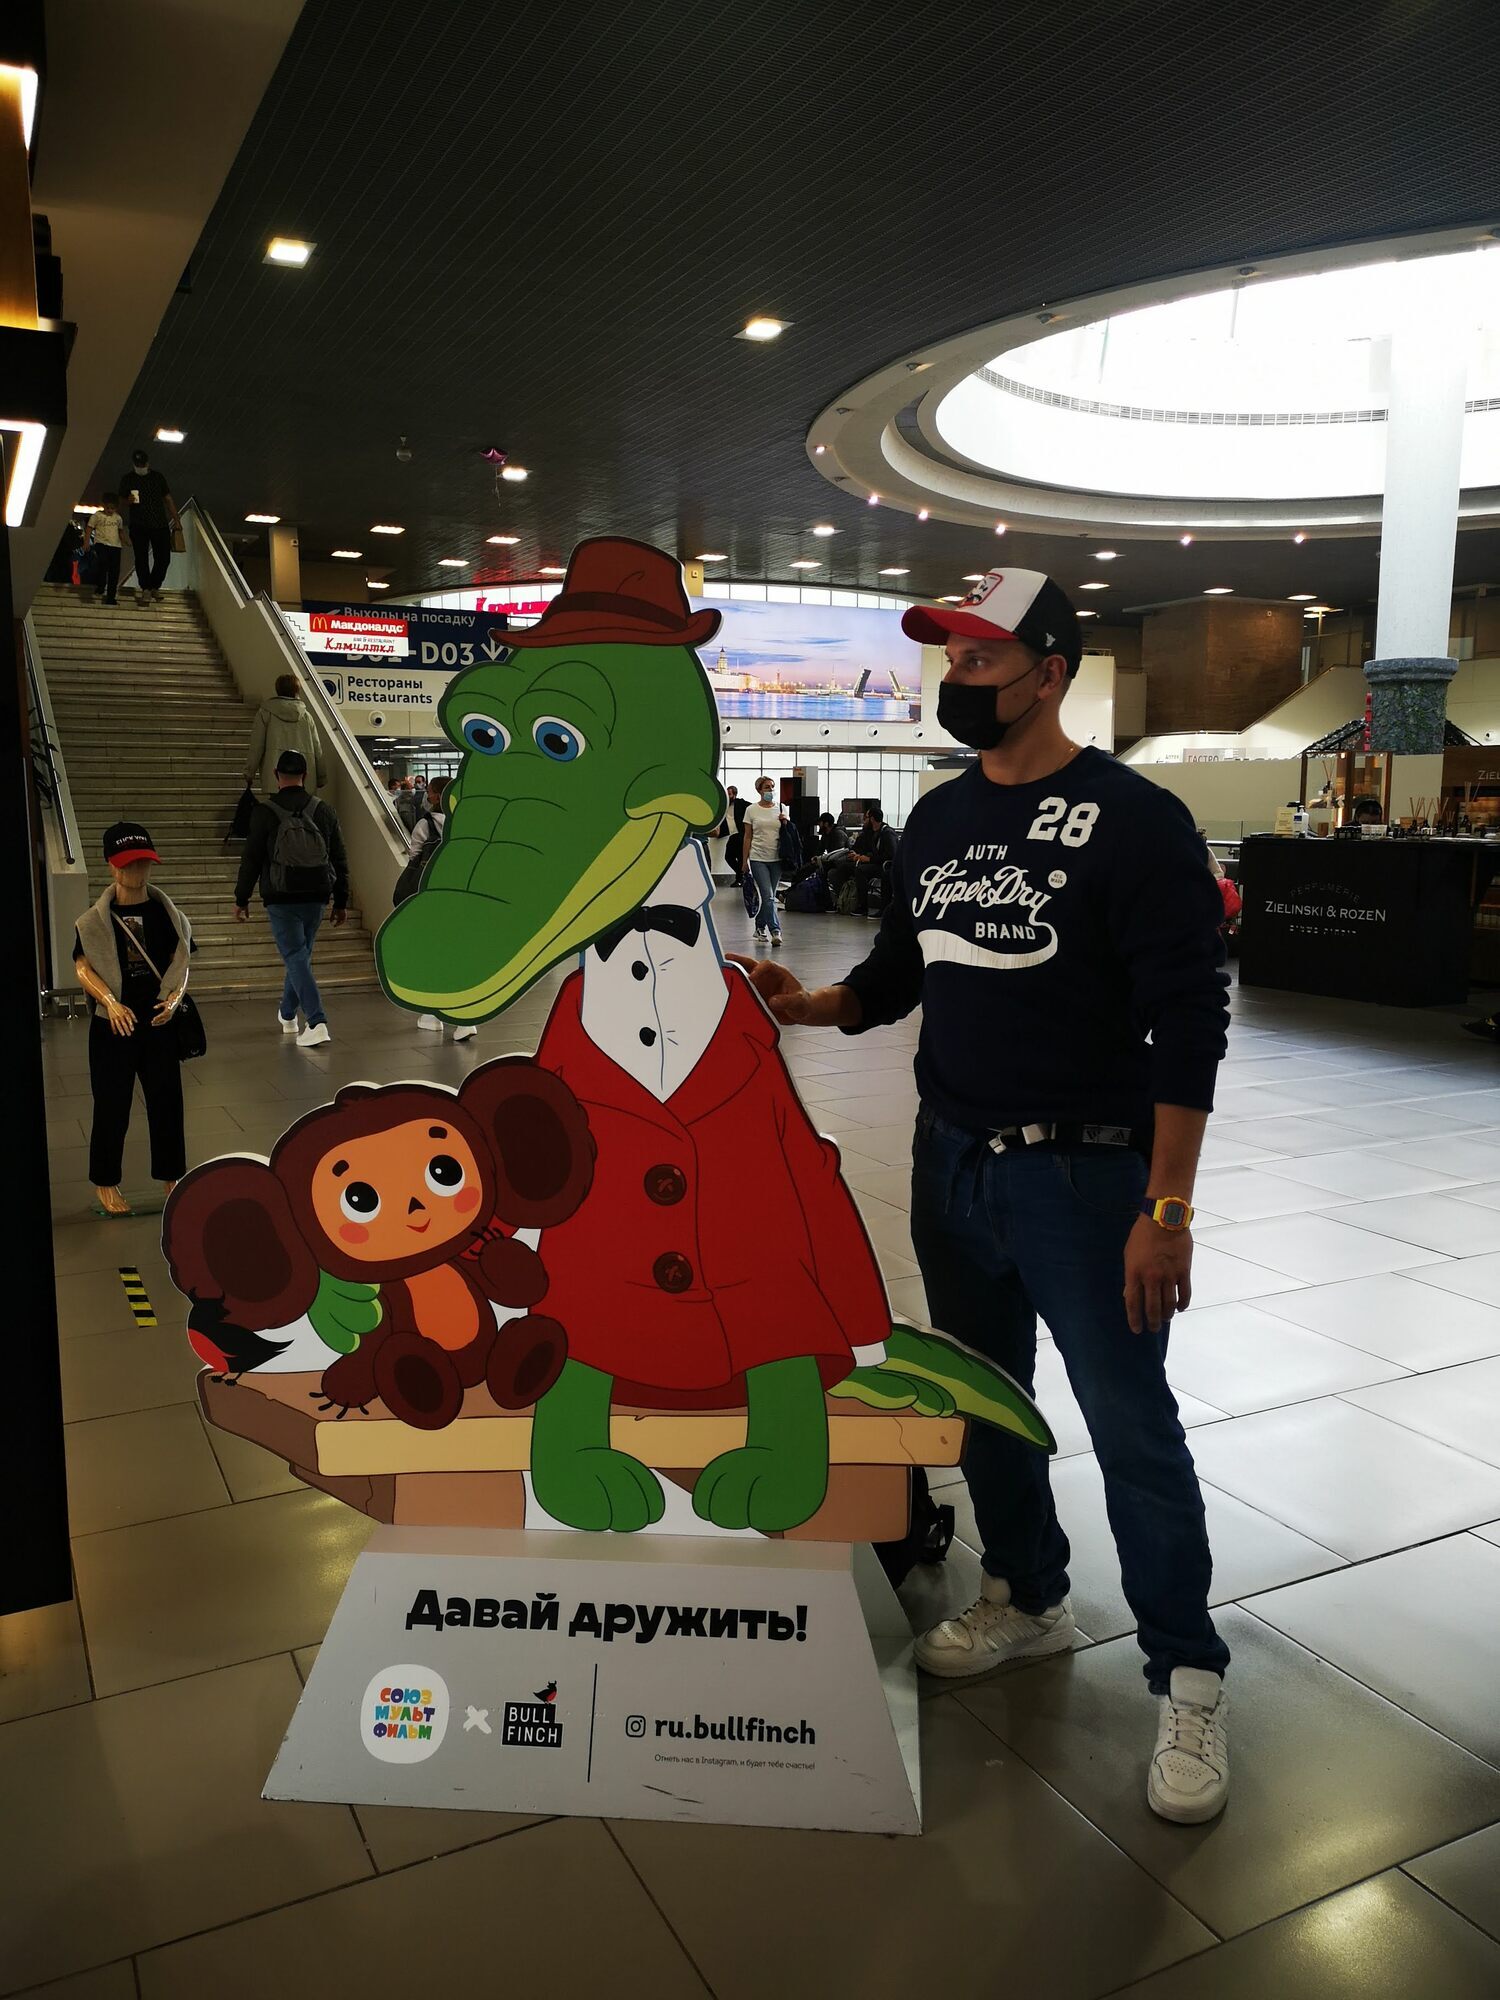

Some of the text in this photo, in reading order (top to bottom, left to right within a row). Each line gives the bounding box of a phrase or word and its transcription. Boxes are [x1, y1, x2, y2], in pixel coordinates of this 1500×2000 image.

[331, 619, 405, 634] Макдоналдс
[403, 611, 418, 623] на
[422, 612, 476, 628] посадку
[348, 676, 423, 690] Рестораны
[348, 690, 433, 704] Restaurants
[1026, 796, 1101, 848] 28
[964, 844, 1008, 861] AUTH
[1265, 899, 1386, 922] ZIELINSKI & ROZEN
[975, 921, 1036, 940] BRAND
[405, 1589, 809, 1643] Давай дружить!
[380, 1687, 433, 1705] СОЮЗ
[375, 1704, 436, 1722] МУЛЬТ
[508, 1706, 551, 1724] BULL
[373, 1722, 433, 1740] ФИЛЬМ
[507, 1726, 558, 1743] FINCH
[655, 1714, 816, 1745] ru.bullfinch
[654, 1754, 681, 1763] Отметь
[701, 1756, 739, 1767] Instagram,
[746, 1759, 766, 1769] будет
[768, 1760, 784, 1769] тебе
[785, 1762, 816, 1770] счастье!
